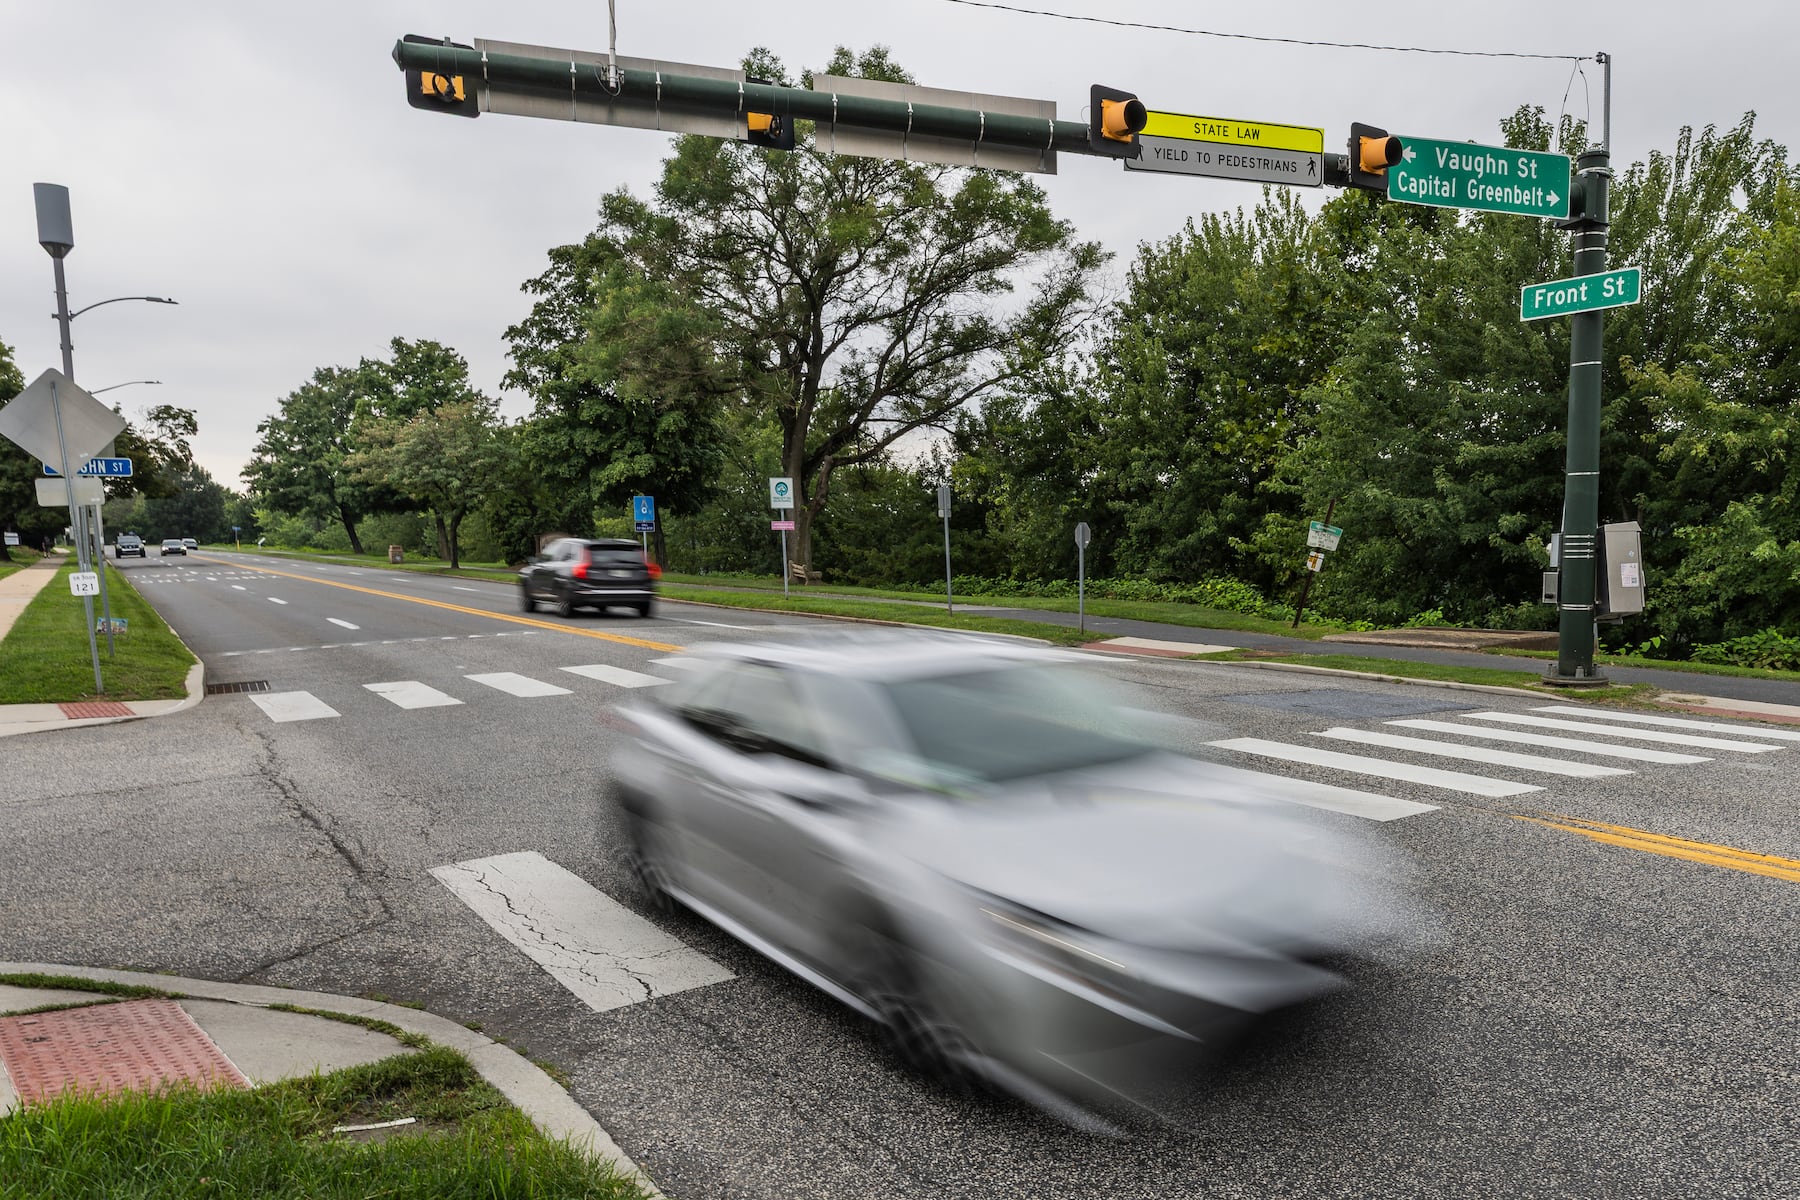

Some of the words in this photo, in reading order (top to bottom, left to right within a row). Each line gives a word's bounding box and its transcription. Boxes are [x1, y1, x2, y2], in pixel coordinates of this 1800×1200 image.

[1194, 122, 1229, 137] STATE
[1237, 127, 1260, 140] LAW
[1154, 147, 1188, 162] YIELD
[1196, 151, 1211, 164] TO
[1218, 154, 1297, 173] PEDESTRIANS
[1435, 147, 1508, 179] Vaughn
[1517, 157, 1538, 179] St
[1397, 171, 1456, 198] Capital
[1467, 179, 1543, 207] Greenbelt
[1534, 282, 1588, 309] Front
[1602, 275, 1625, 298] St
[112, 462, 124, 473] ST
[76, 583, 94, 592] 121
